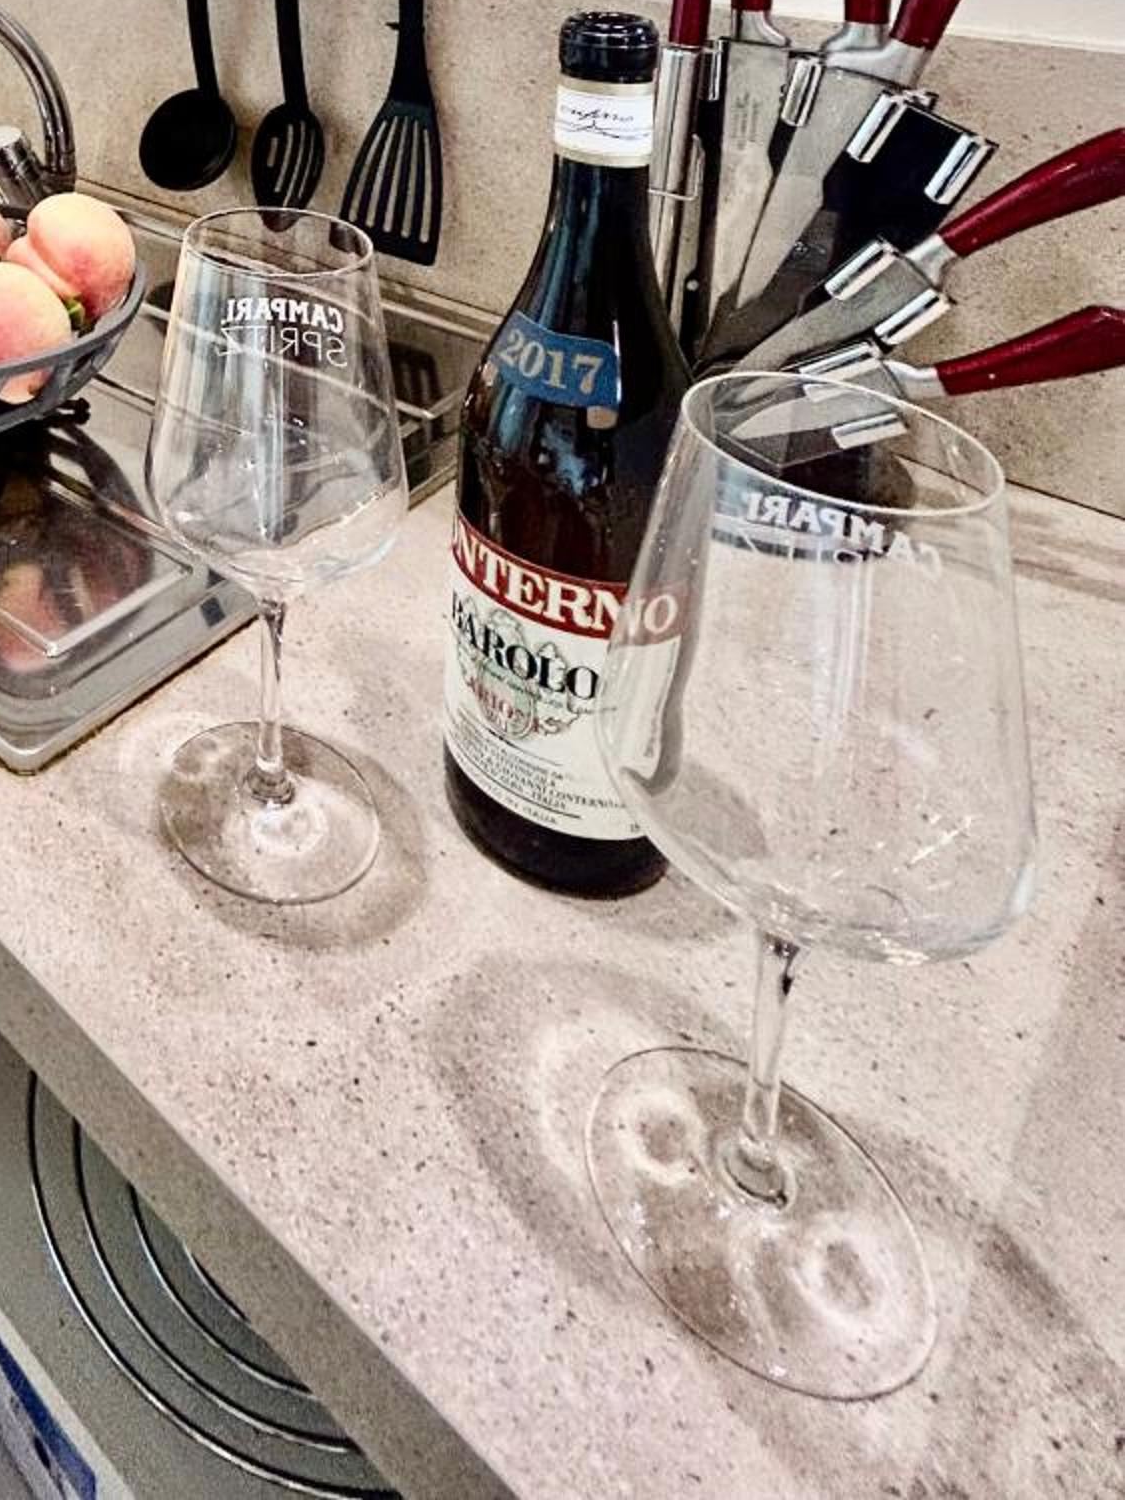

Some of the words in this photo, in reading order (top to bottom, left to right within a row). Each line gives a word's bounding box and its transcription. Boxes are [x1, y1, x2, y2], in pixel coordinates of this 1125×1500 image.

[498, 328, 604, 395] 2017
[453, 512, 679, 635] NTERNO
[452, 589, 599, 701] BAROLO
